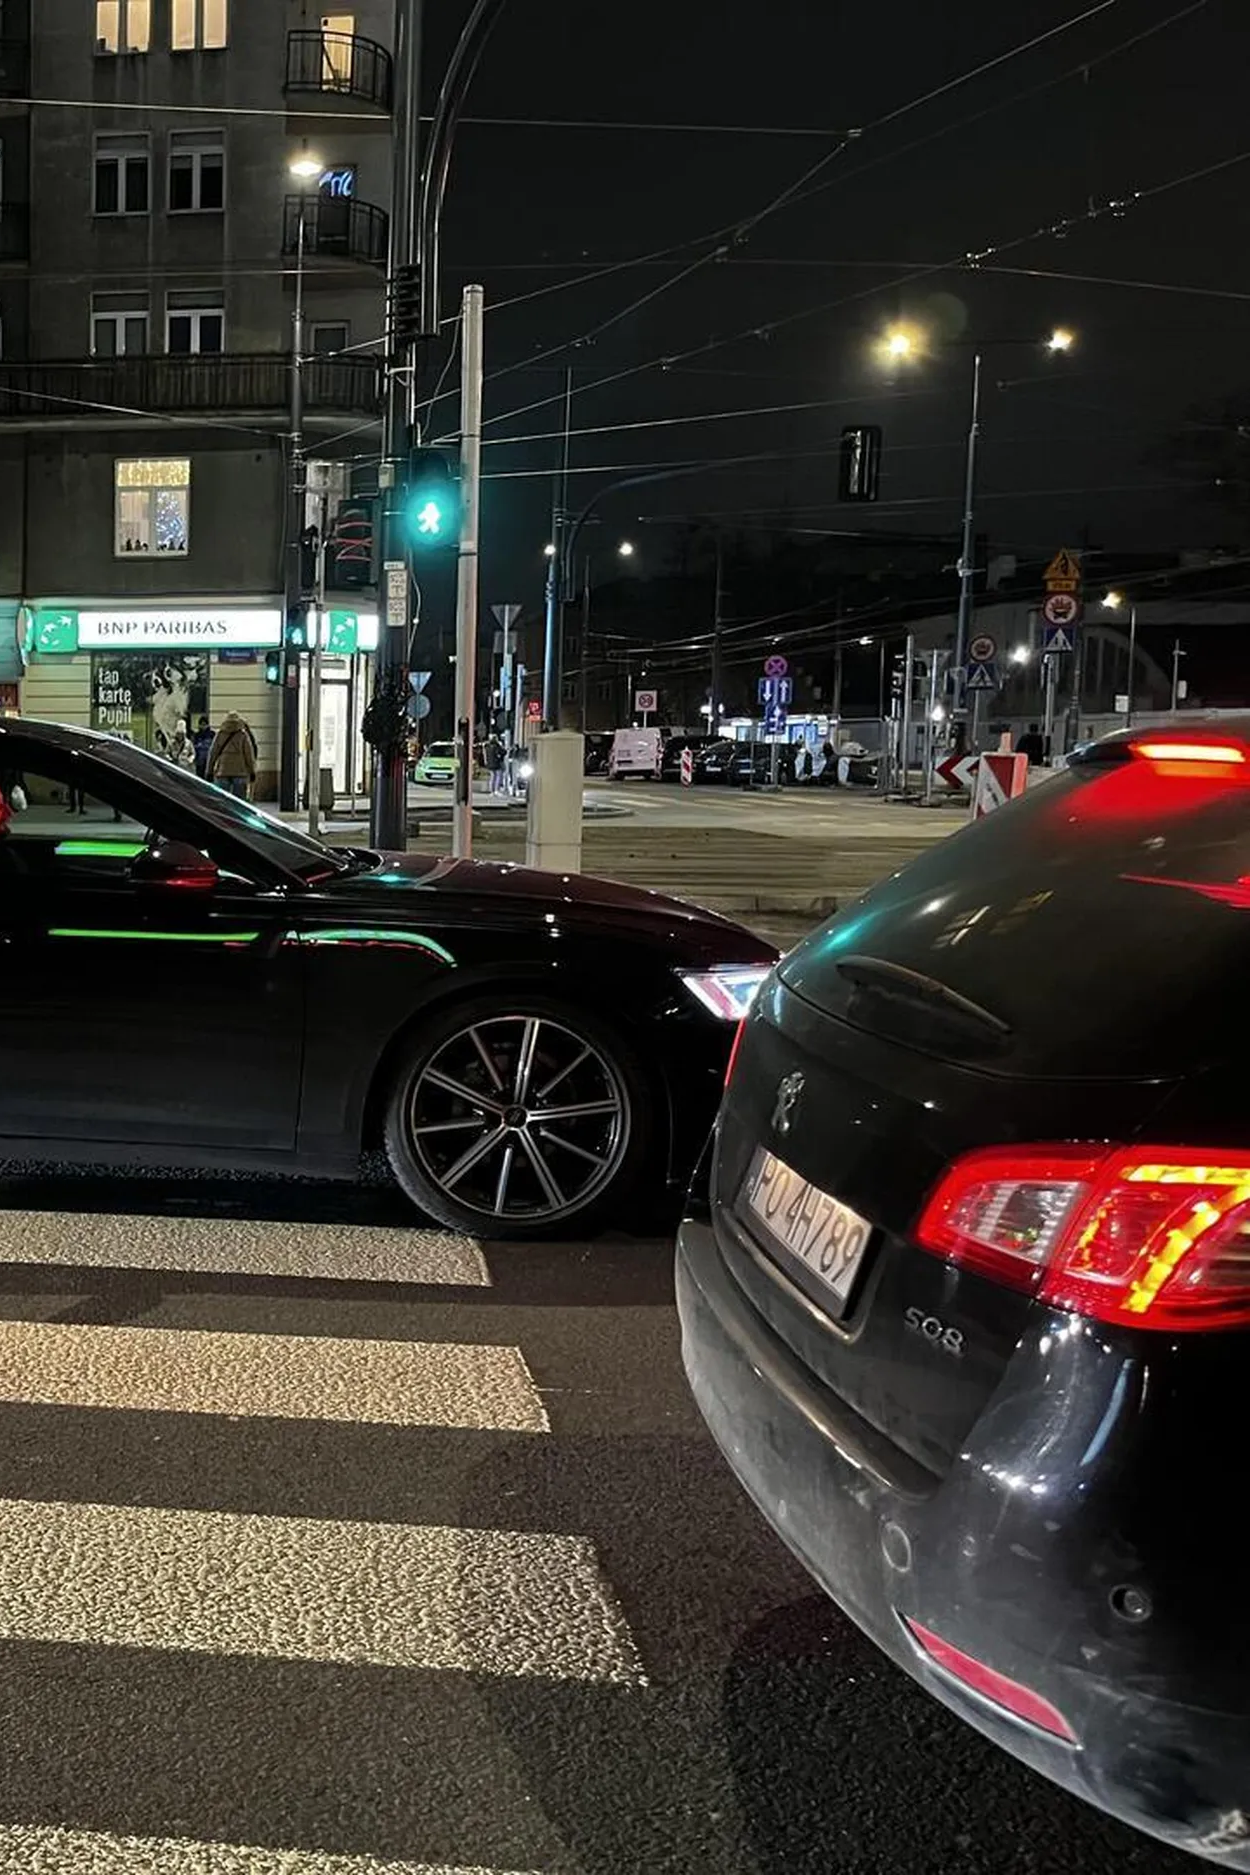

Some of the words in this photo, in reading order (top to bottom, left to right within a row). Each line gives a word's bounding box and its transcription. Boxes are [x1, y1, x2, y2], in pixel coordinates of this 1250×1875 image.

[98, 620, 138, 635] BNP
[143, 620, 227, 635] PARIBAS
[98, 686, 132, 706] kartę
[98, 706, 132, 728] Pupil
[751, 1157, 791, 1219] PO
[785, 1182, 865, 1284] 4H789
[904, 1306, 964, 1353] 508
